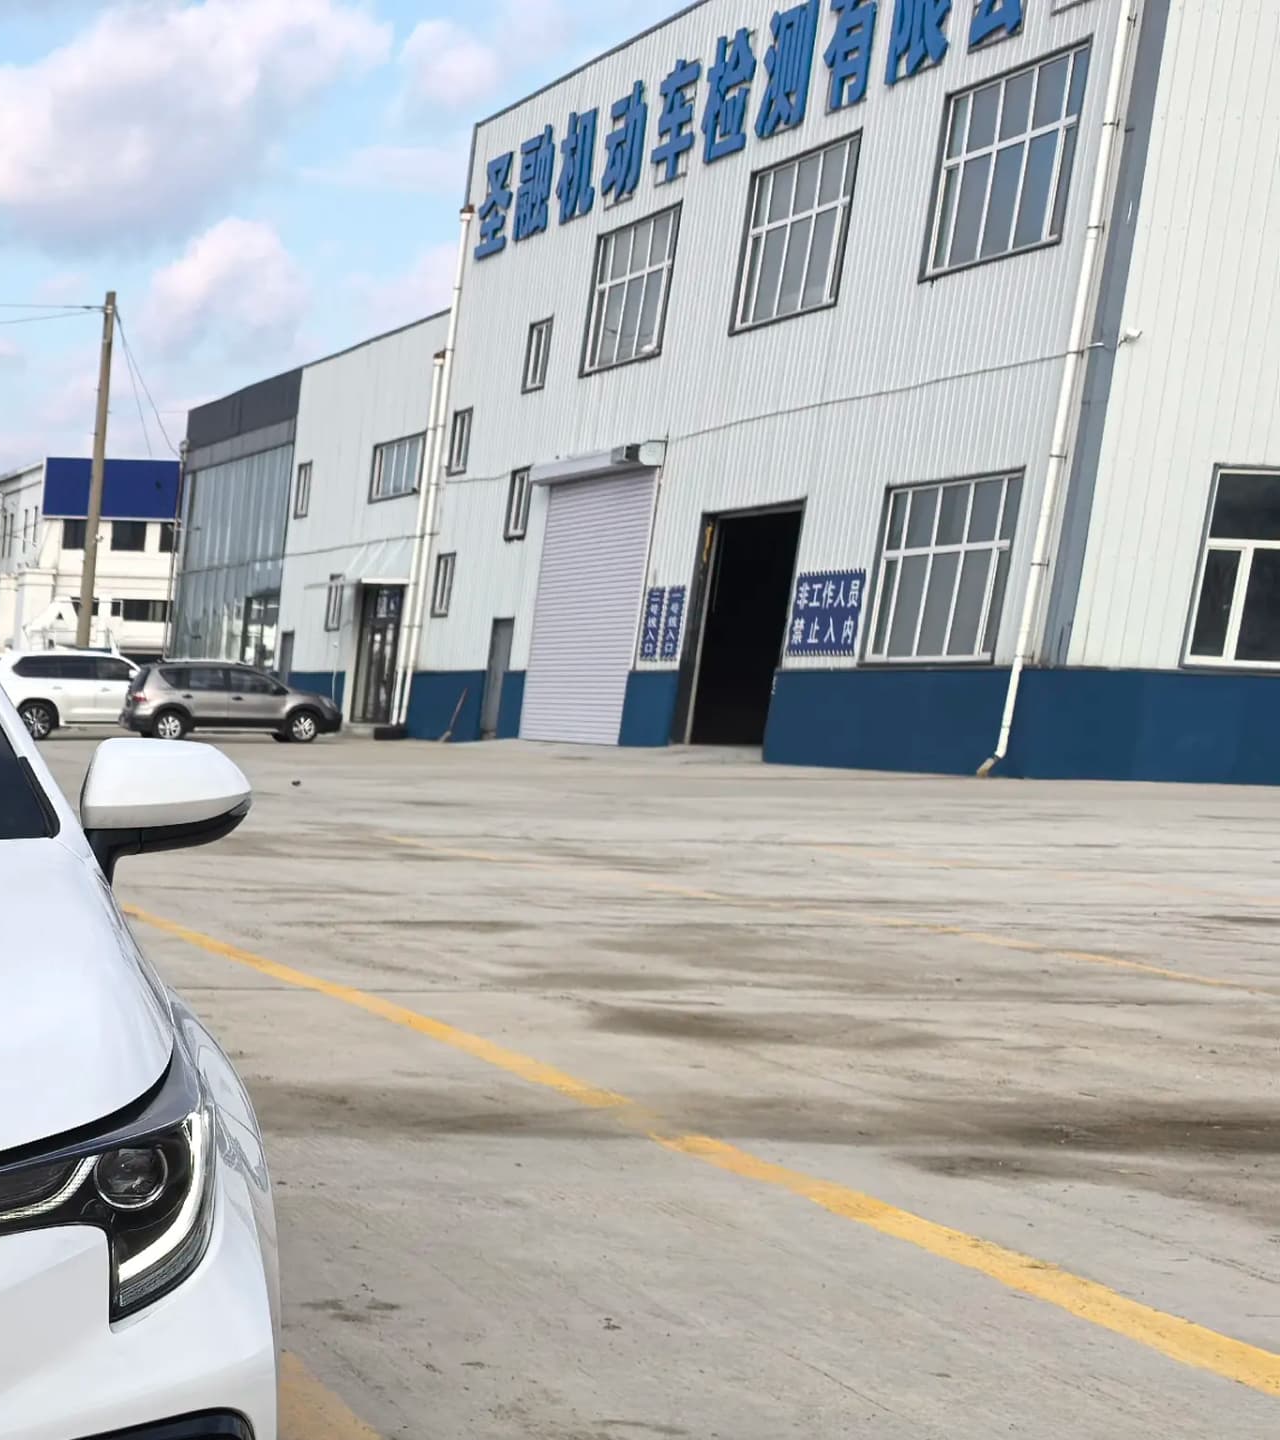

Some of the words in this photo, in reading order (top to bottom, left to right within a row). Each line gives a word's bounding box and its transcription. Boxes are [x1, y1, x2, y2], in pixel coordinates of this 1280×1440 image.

[796, 579, 860, 610] 非工作人员
[790, 615, 854, 645] 禁止入内
